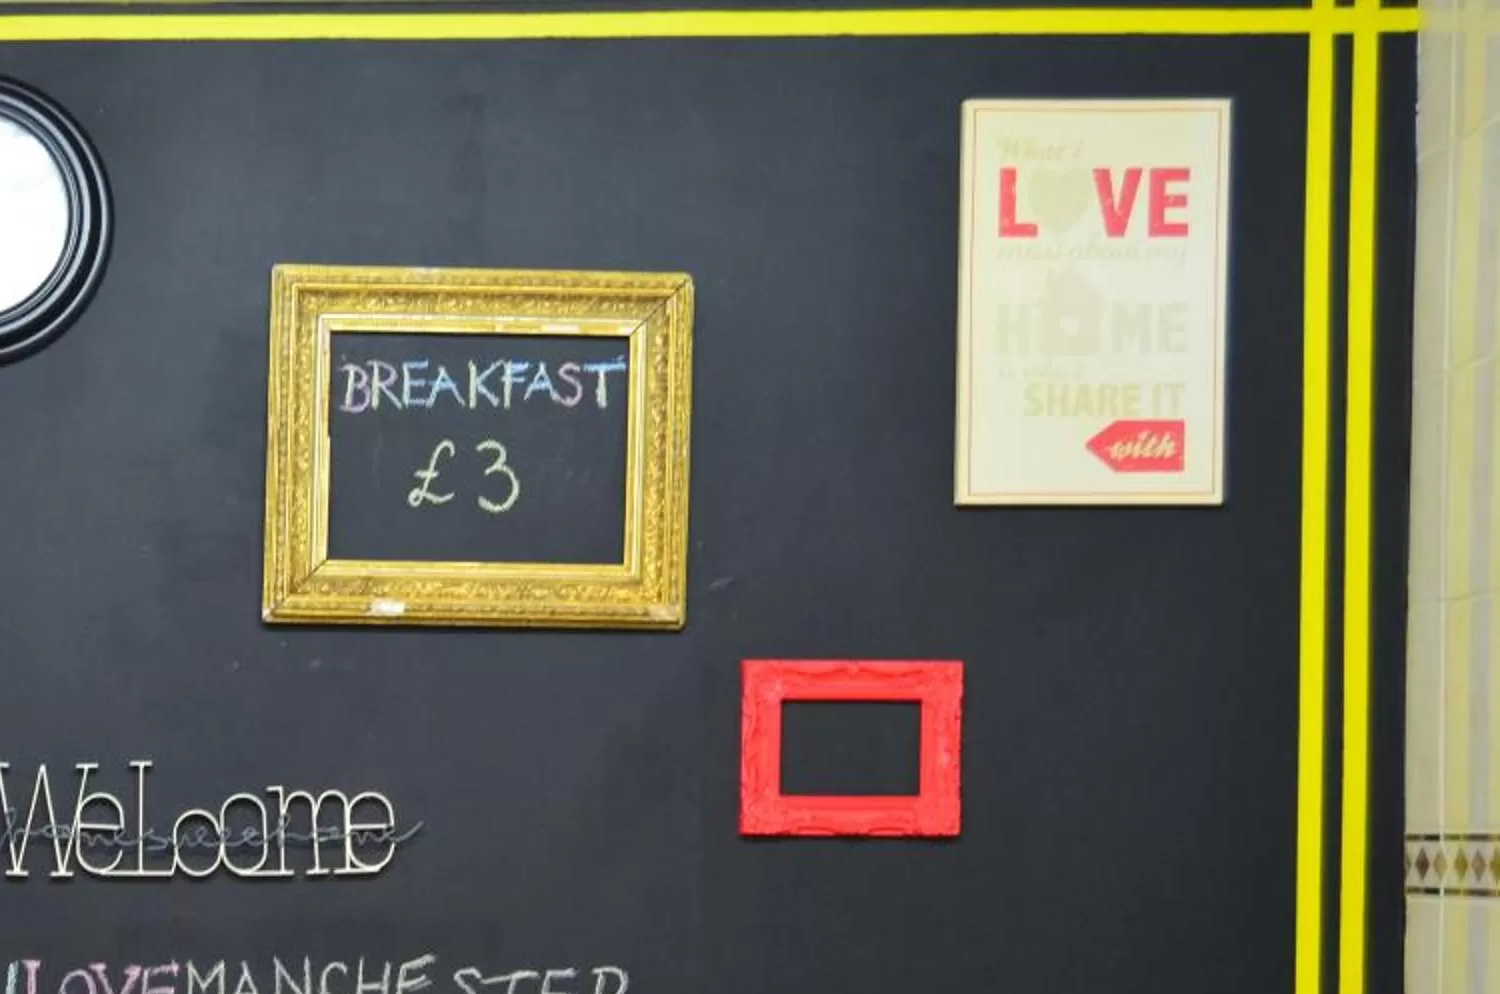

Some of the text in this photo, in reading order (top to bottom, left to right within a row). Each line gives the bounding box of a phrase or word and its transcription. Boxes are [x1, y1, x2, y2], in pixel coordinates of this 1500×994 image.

[339, 353, 628, 415] BREAKFAST
[1023, 381, 1188, 417] SHARE IT
[1104, 429, 1177, 463] with
